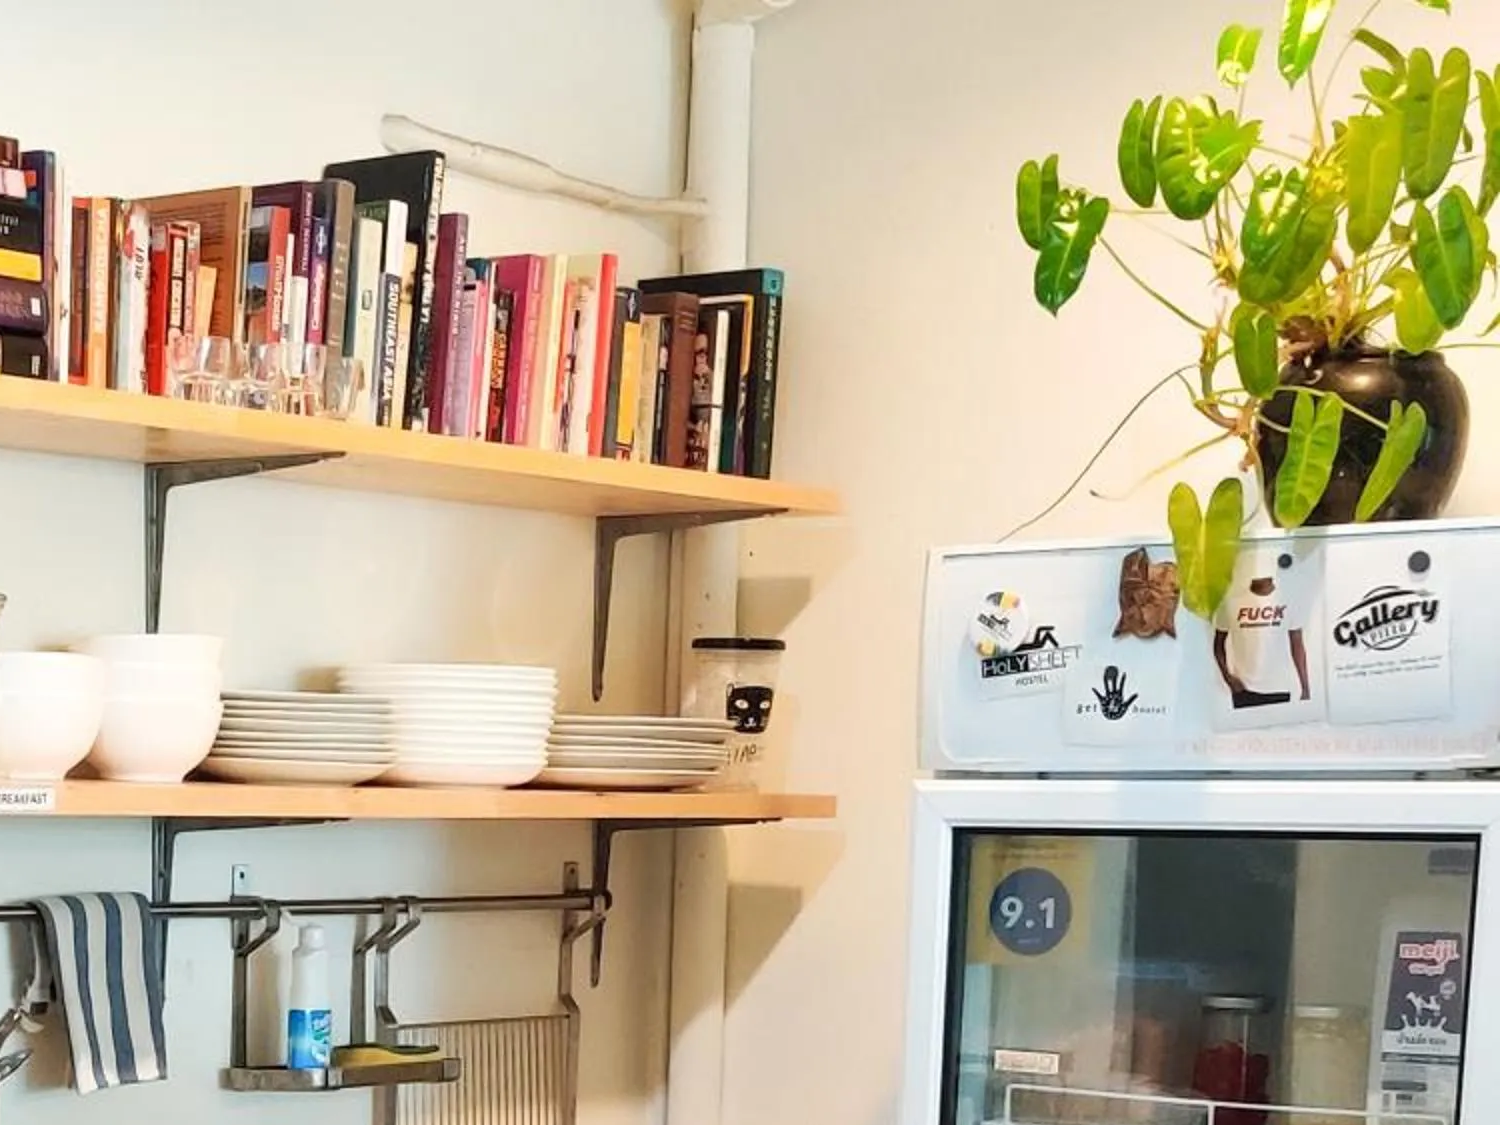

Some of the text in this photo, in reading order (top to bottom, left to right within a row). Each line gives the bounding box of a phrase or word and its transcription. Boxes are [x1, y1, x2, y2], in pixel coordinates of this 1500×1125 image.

[381, 280, 400, 401] SOUTHEAST ASIA
[1237, 604, 1287, 621] FUCK
[1333, 599, 1438, 648] Gallery
[1076, 703, 1098, 715] get
[1000, 895, 1056, 929] 9.1
